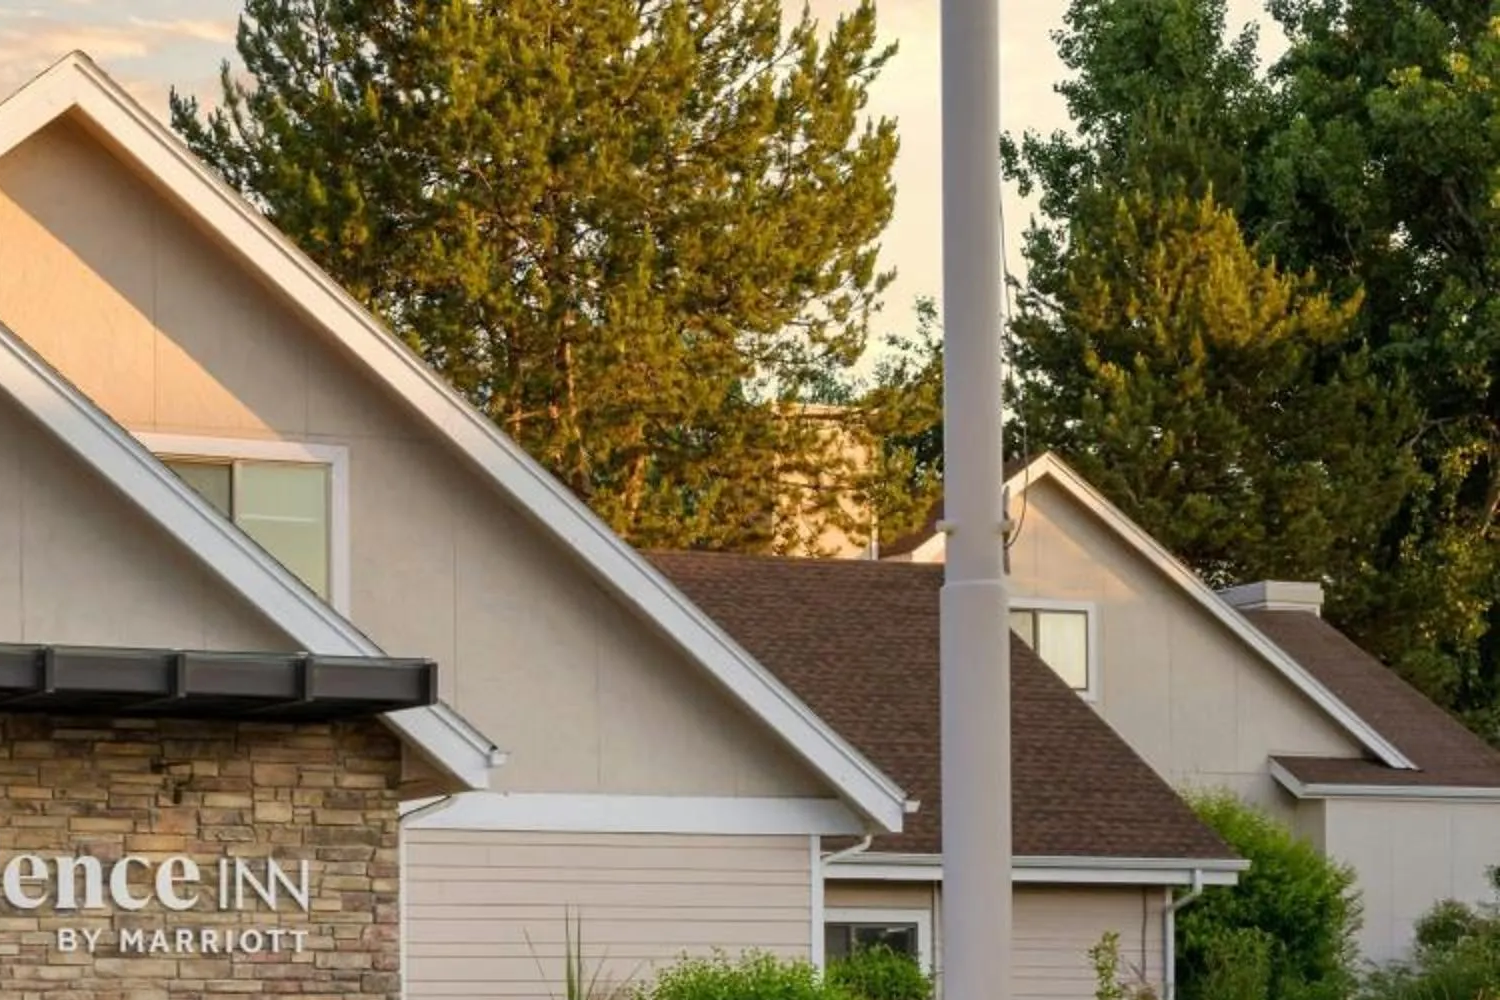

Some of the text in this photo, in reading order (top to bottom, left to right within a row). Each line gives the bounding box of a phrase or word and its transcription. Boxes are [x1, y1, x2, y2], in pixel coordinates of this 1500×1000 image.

[218, 858, 311, 912] INN
[57, 928, 311, 954] BY MARRIOTT
